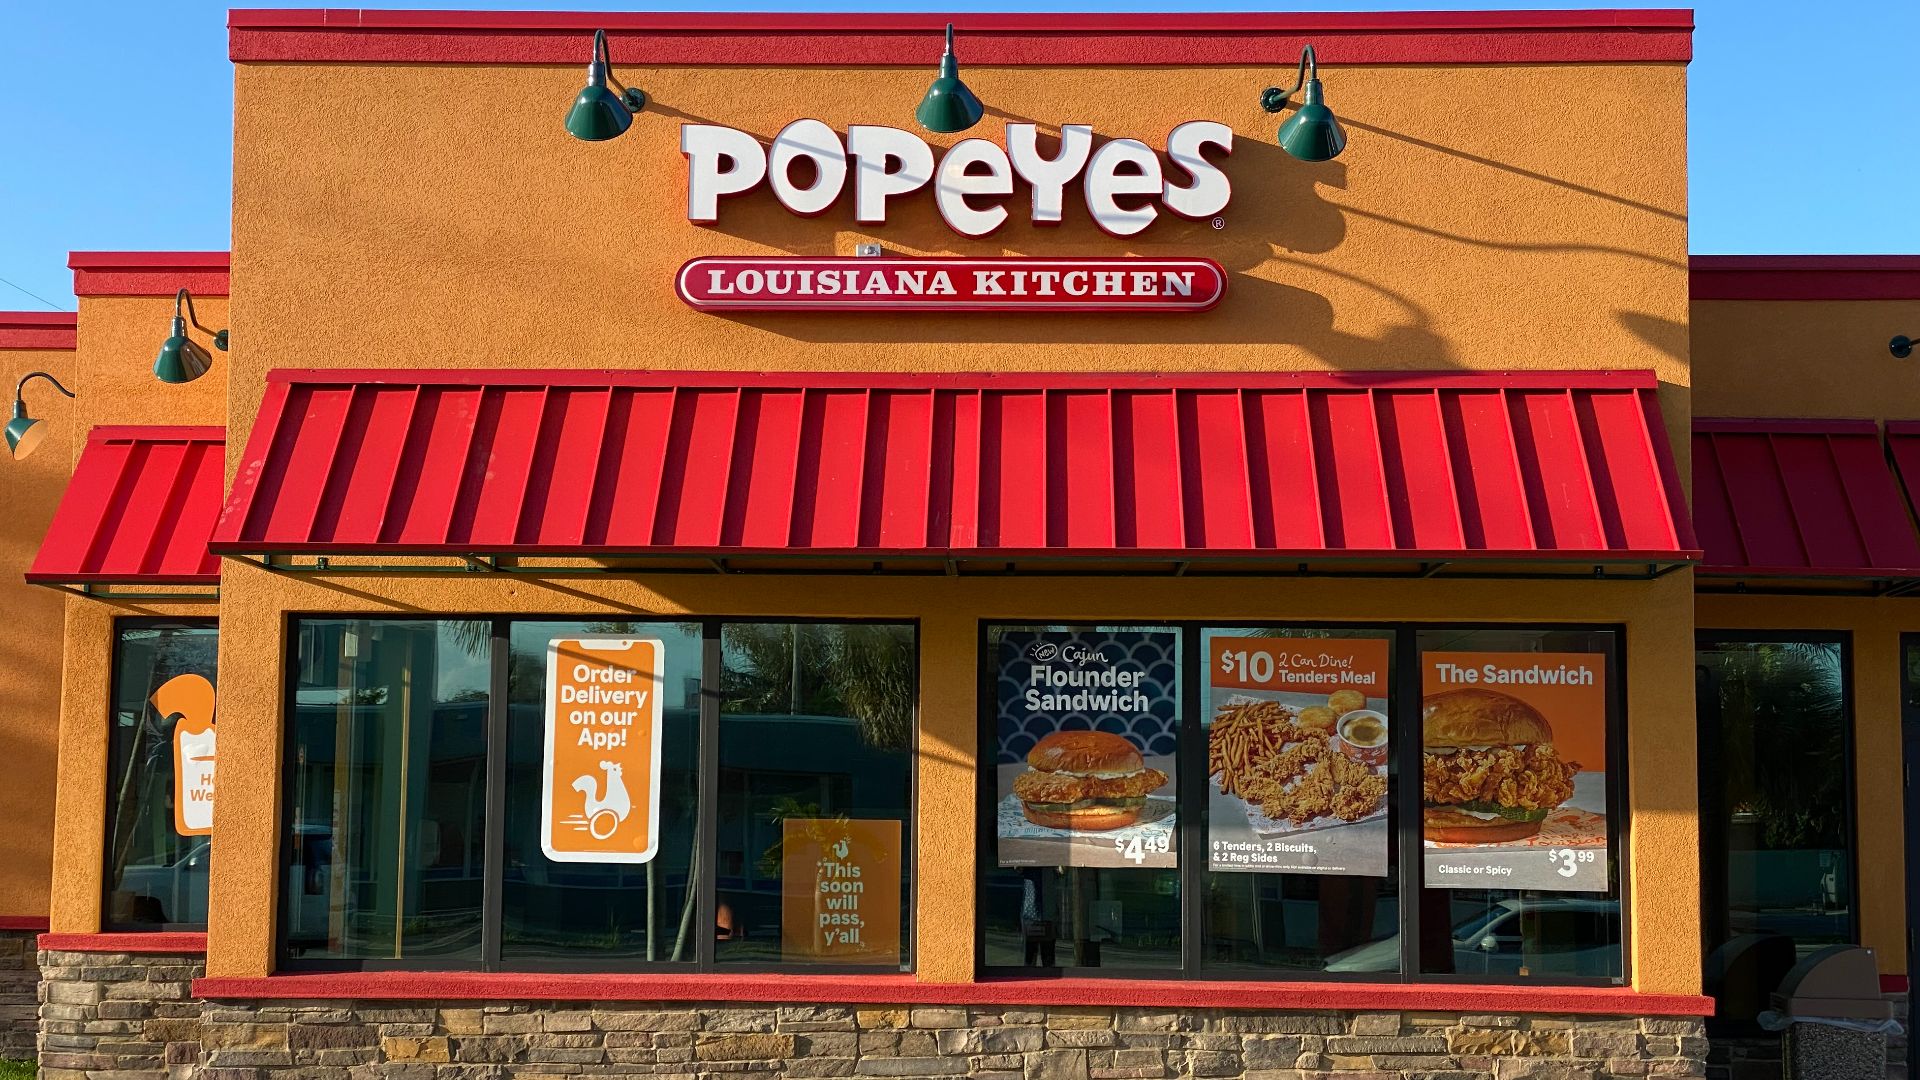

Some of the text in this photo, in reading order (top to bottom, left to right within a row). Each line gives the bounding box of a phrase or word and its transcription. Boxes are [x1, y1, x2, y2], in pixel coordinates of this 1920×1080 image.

[708, 269, 1194, 297] LOUISIANA KITCHEN
[1062, 646, 1108, 666] Cajun
[1278, 652, 1354, 669] 2 Can Dine!
[573, 664, 637, 684] Order
[1221, 650, 1275, 683] $10
[1435, 663, 1593, 686] The Sandwich
[1030, 665, 1145, 687] Flounder
[1278, 669, 1375, 685] Tenders Meal
[561, 685, 648, 709] Delivery
[1025, 689, 1149, 712] Sandwich
[569, 711, 638, 726] on our
[578, 728, 627, 750] App!
[1213, 841, 1317, 855] 6 Tenders, 2 Biscuits,
[1213, 853, 1278, 864] & 2 Reg Sides
[824, 863, 861, 878] This
[1438, 864, 1512, 877] Classic or Spicy
[820, 881, 864, 893] soon
[826, 894, 858, 910] will
[819, 912, 865, 929] pass,
